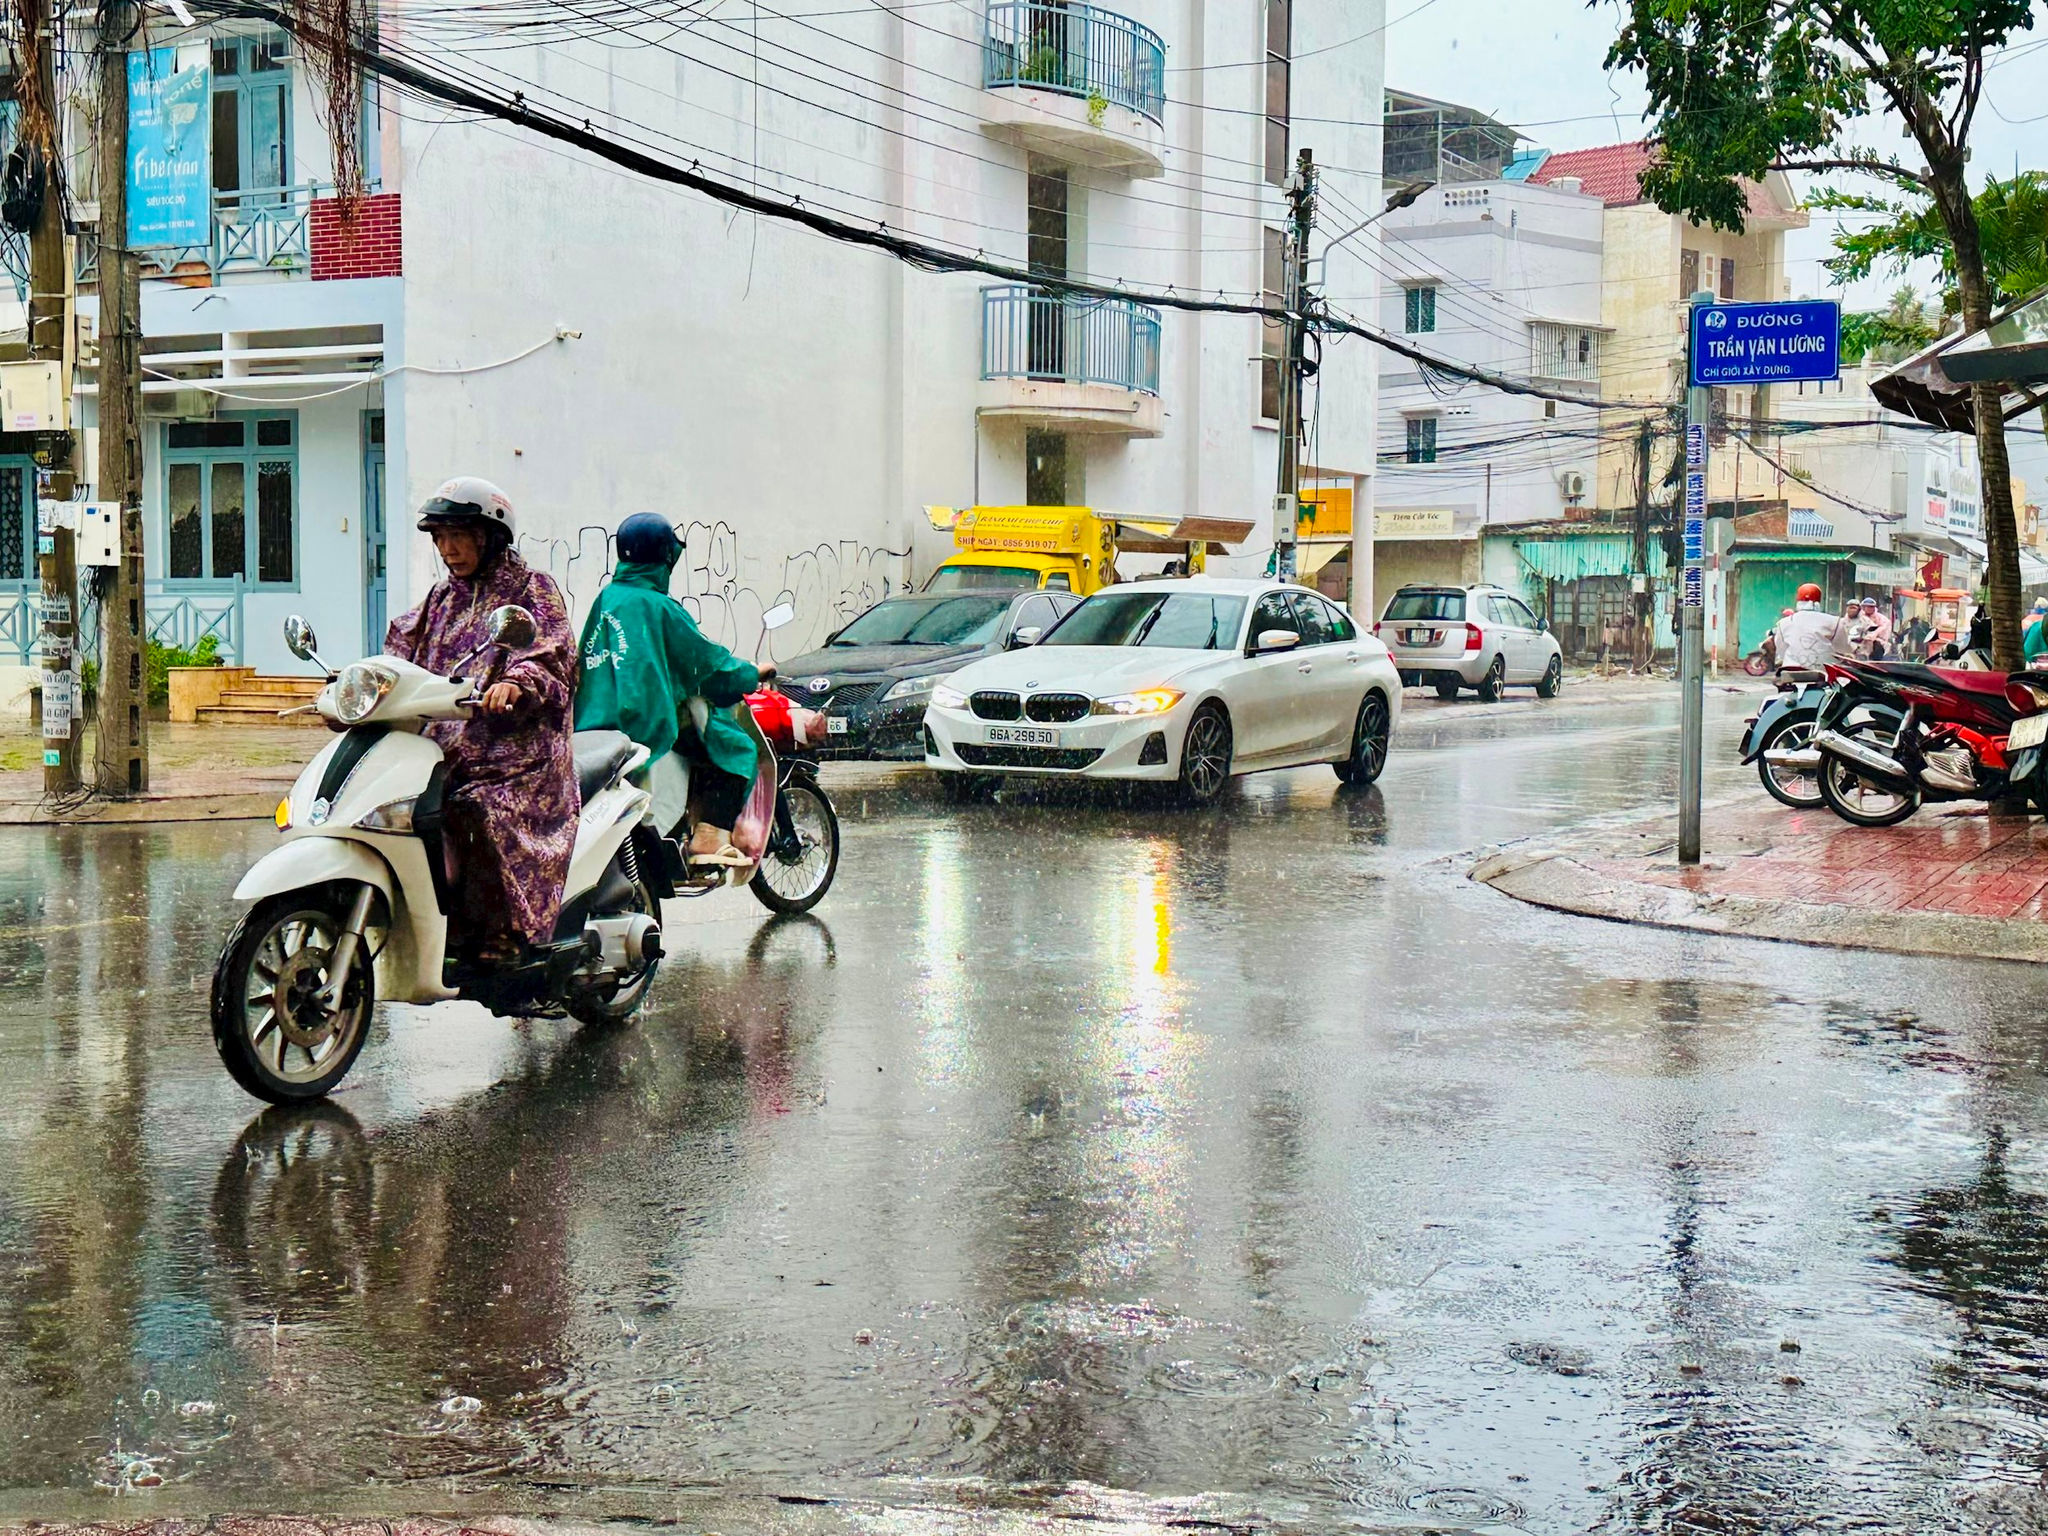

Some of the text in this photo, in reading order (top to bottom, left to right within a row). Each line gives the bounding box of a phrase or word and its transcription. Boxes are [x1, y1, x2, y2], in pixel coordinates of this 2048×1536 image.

[1737, 312, 1803, 329] ĐƯỜNG
[1708, 334, 1825, 362] TRẦN VĂN LƯƠNG
[1703, 364, 1720, 377] CHỈ
[1721, 365, 1741, 376] GIỚI
[1743, 364, 1761, 376] XÂY
[957, 536, 975, 545] SHIP
